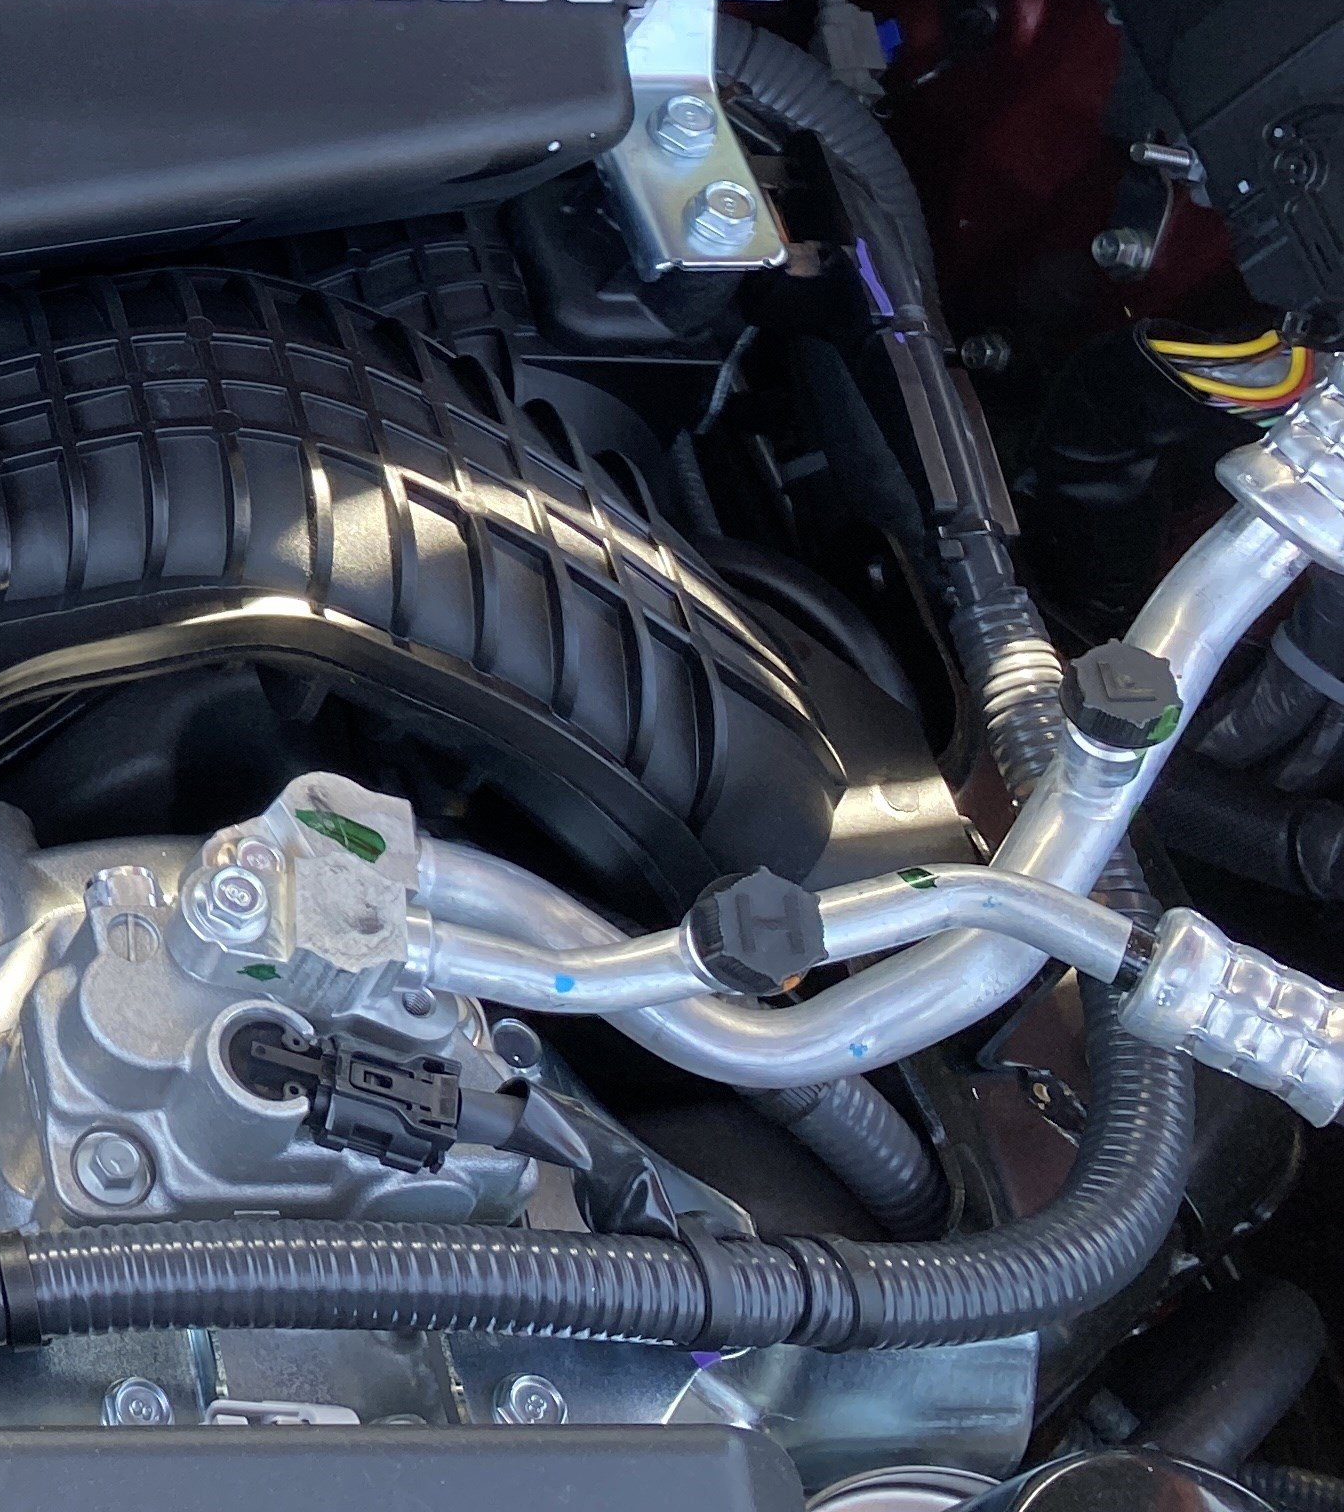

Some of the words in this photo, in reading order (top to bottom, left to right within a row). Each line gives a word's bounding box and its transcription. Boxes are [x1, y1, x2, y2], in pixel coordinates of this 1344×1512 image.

[1097, 660, 1159, 702] L
[224, 884, 252, 907] 8
[734, 892, 806, 955] H
